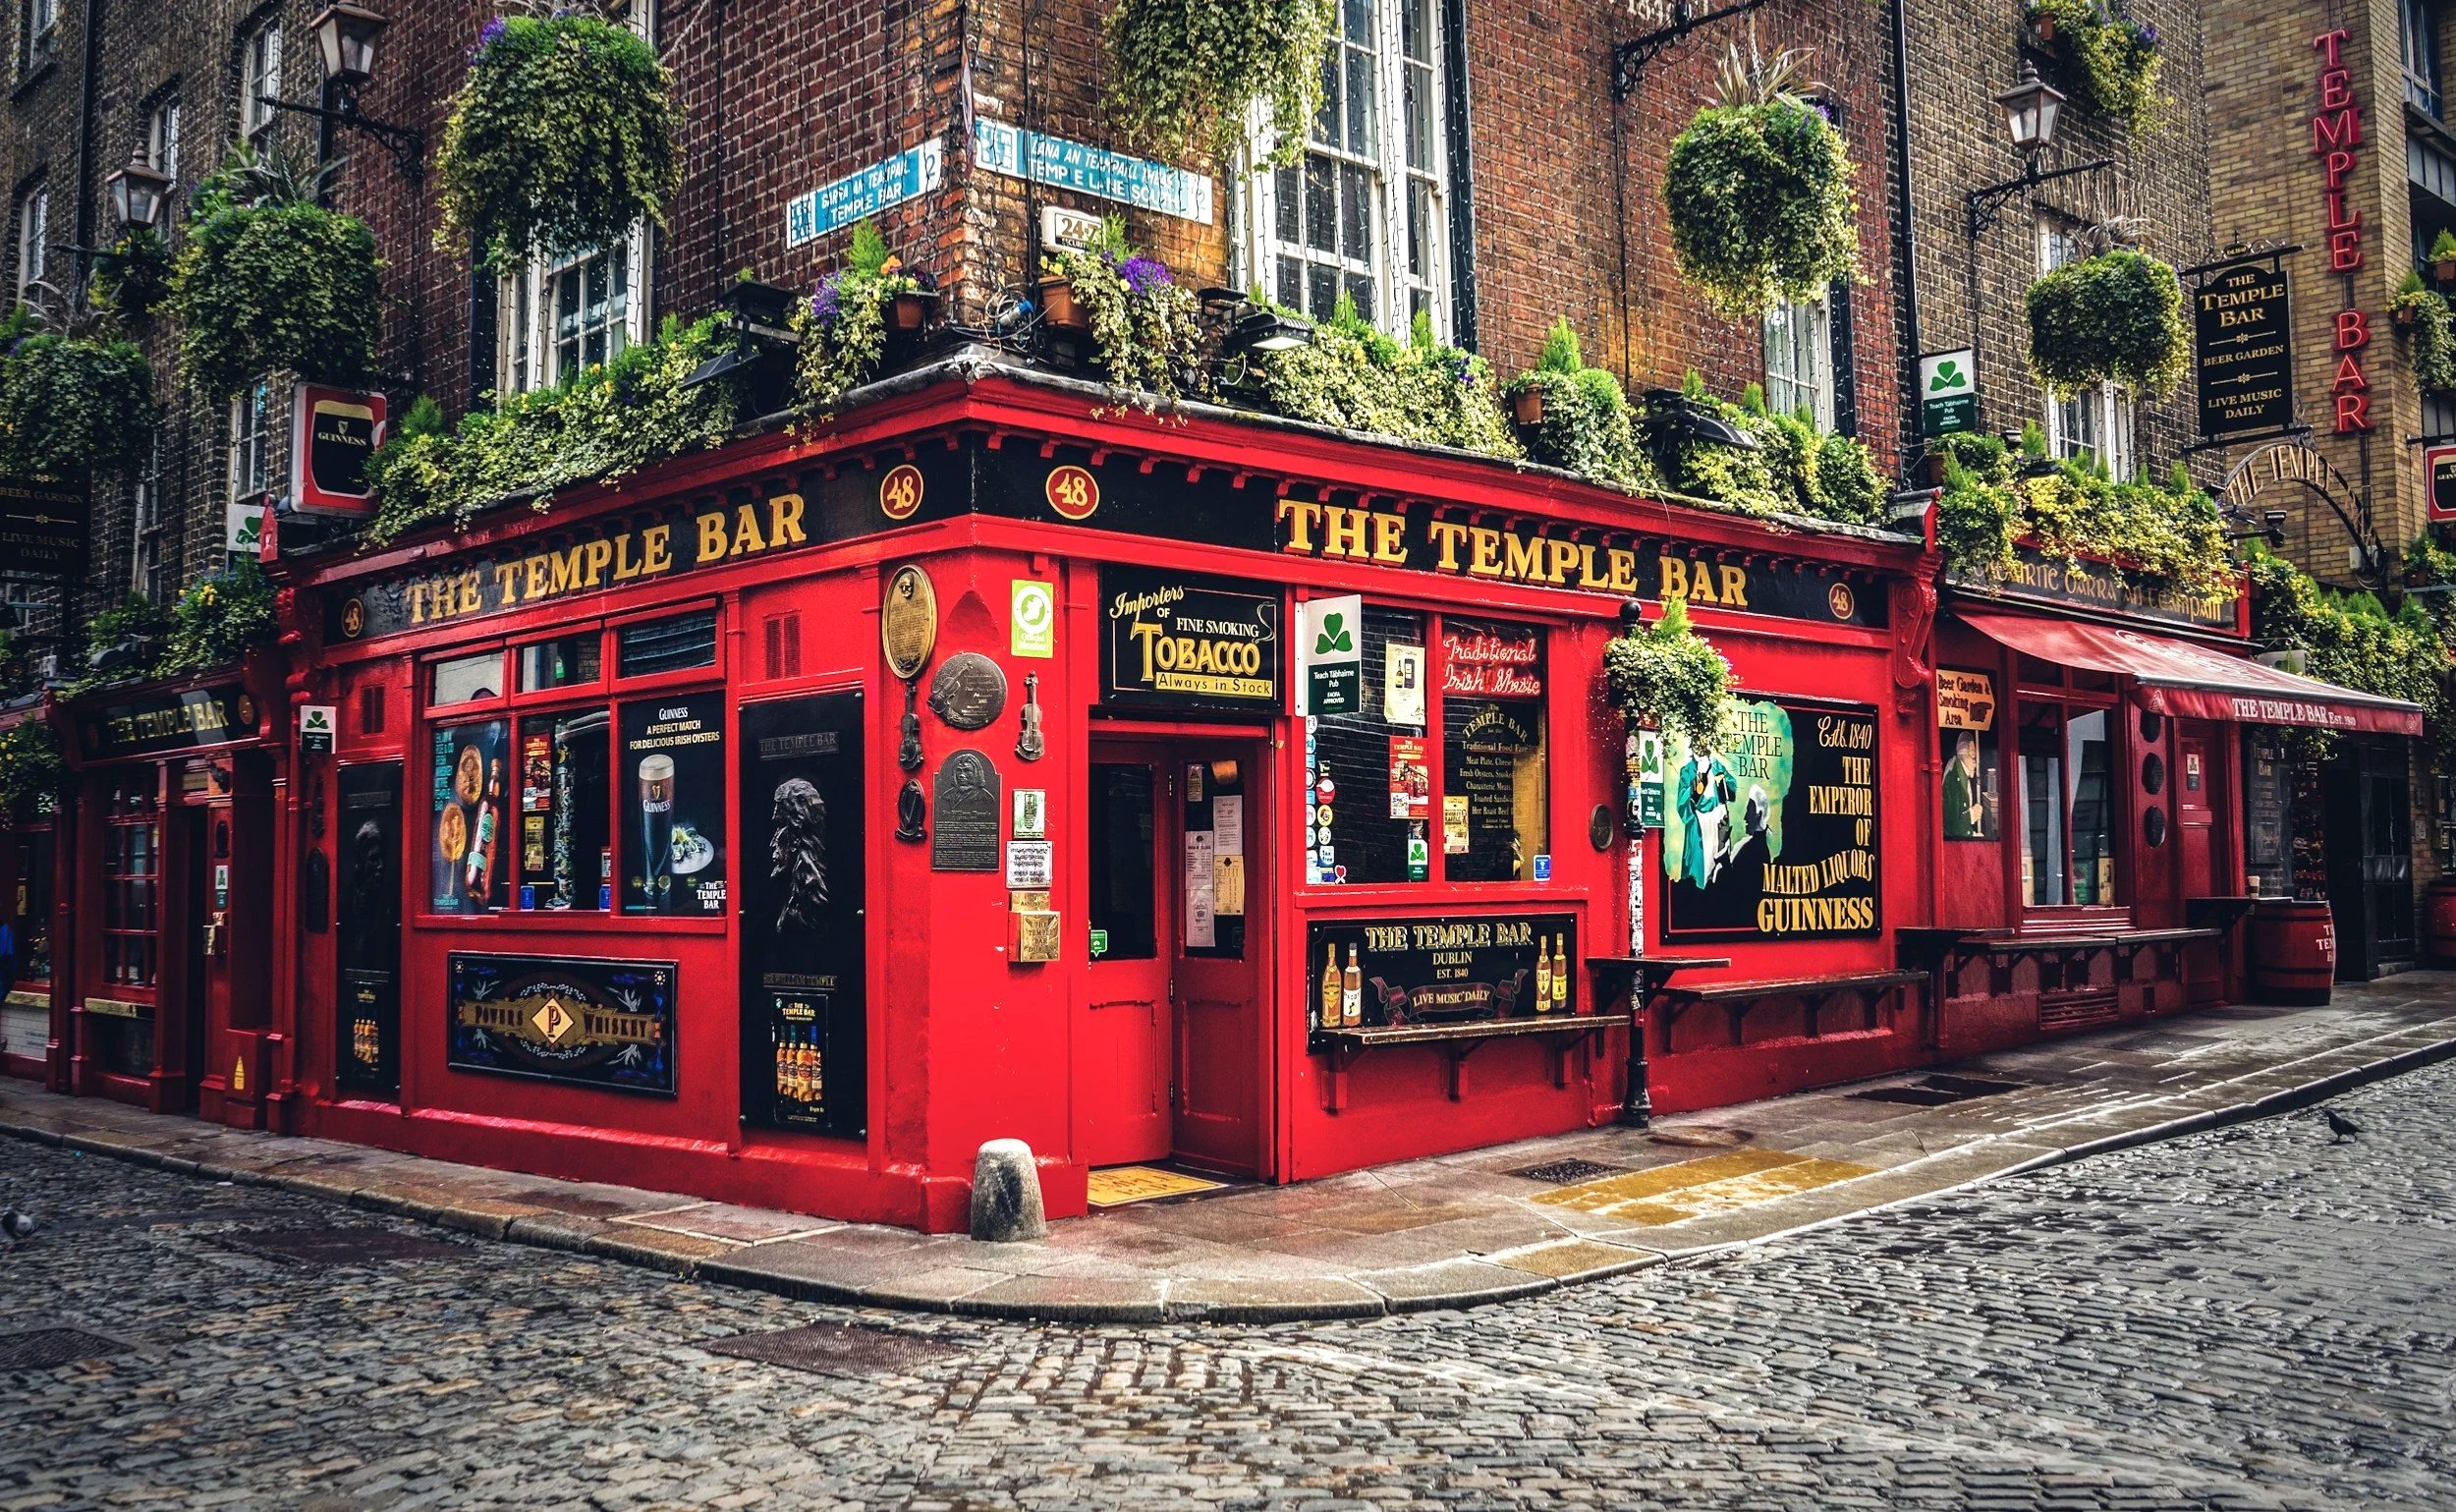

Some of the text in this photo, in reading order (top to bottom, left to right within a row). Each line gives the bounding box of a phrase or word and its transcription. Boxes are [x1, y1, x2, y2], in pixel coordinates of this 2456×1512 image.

[1064, 148, 1082, 164] AN
[1028, 158, 1084, 186] TEMPE
[831, 194, 873, 221] TEMPLE
[2311, 28, 2372, 433] TEMPLE BAR
[2226, 273, 2256, 288] THE
[2199, 283, 2285, 311] TEMPLE
[2220, 308, 2266, 328] BAR
[2203, 345, 2284, 366] BEER GARDEN
[2207, 388, 2282, 409] LIVE MUSIC
[2225, 405, 2265, 420] DAILY
[317, 431, 367, 447] GUINNESS
[887, 476, 915, 510] 48
[1055, 473, 1088, 506] 48
[405, 493, 808, 625] THE TEMPLE BAR
[1278, 499, 1749, 608] THE TEMPLE BAR
[1109, 586, 1184, 621] Importers
[1832, 588, 1848, 611] 48
[1157, 607, 1170, 618] OF
[1176, 618, 1259, 638] FINE SMOKING
[1443, 636, 1536, 660] Traditional
[1158, 674, 1270, 695] Always in Stock
[1328, 679, 1339, 688] Pub
[1442, 664, 1540, 694] Irish Music
[1937, 674, 1954, 691] Beer
[1956, 676, 1982, 694] Garden
[1938, 692, 1969, 712] Smoking
[2232, 698, 2258, 717] THE
[2259, 700, 2306, 721] TEMPLE
[2305, 704, 2328, 724] BAR
[192, 700, 230, 731] BAR
[659, 707, 688, 720] GUINNESS
[1738, 711, 1768, 733] THE
[1945, 710, 1962, 725] Area
[652, 722, 679, 734] PERFECT
[679, 719, 700, 731] MATCH
[1463, 712, 1528, 742] TEMPLE BAR
[1849, 723, 1872, 749] 1840
[630, 731, 720, 750] FOR DELICIOUS IRISH OYSTERS
[1725, 734, 1782, 756] TEMPLE
[1738, 756, 1769, 779] BAR
[1843, 756, 1870, 785] THE
[643, 799, 671, 812] GUINNESS
[1809, 785, 1872, 816] EMPEROR
[1856, 818, 1871, 846] OF
[1762, 849, 1875, 894] MALTED LIQUORS
[697, 889, 726, 899] TEMPLE
[703, 900, 719, 909] BAR
[1758, 897, 1873, 932] GUINNESS
[1365, 922, 1534, 951] THE TEMPLE BAR
[1432, 951, 1473, 966] DUBLIN
[1436, 968, 1469, 980] EST. 1840
[1413, 990, 1490, 1007] LIVE MUSIC DAILY
[475, 1005, 523, 1026] POWERS
[547, 1005, 561, 1034] P
[804, 1008, 816, 1017] BAR
[584, 1012, 647, 1037] WHISKEY
